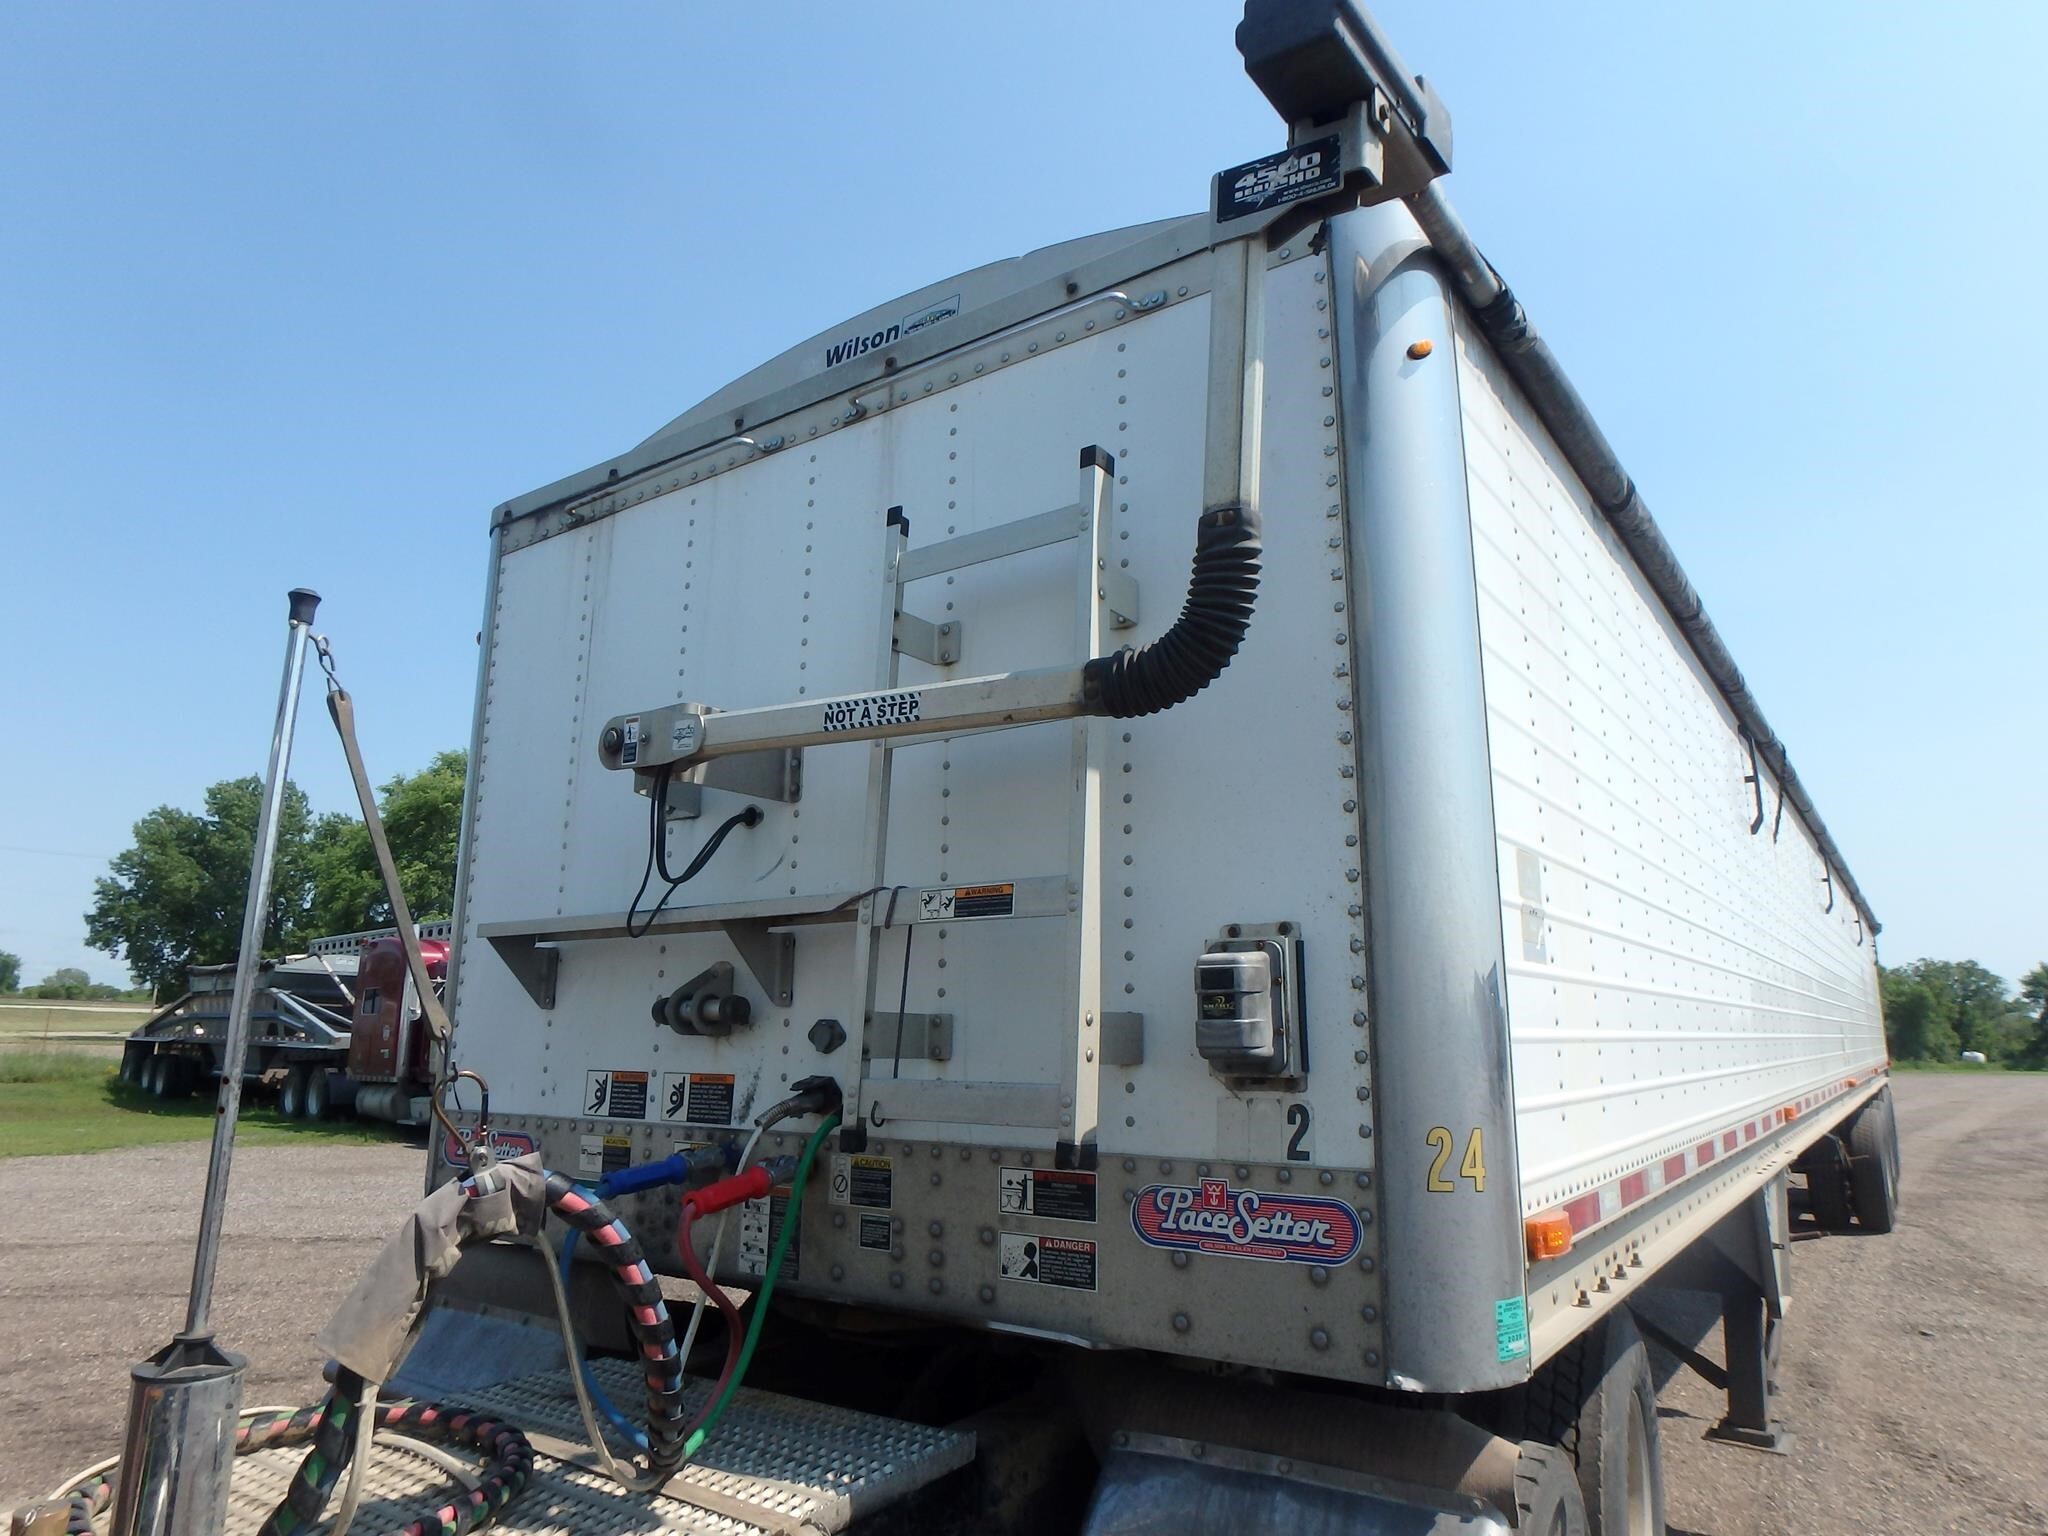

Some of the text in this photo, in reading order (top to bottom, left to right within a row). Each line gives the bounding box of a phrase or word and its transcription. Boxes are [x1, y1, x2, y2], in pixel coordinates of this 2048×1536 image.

[826, 324, 900, 368] Wilson
[824, 700, 919, 725] NOT A STEP
[1286, 1103, 1311, 1161] 2
[858, 1159, 891, 1168] CAUTION
[1426, 1126, 1486, 1192] 24
[1053, 1239, 1091, 1253] DANGER
